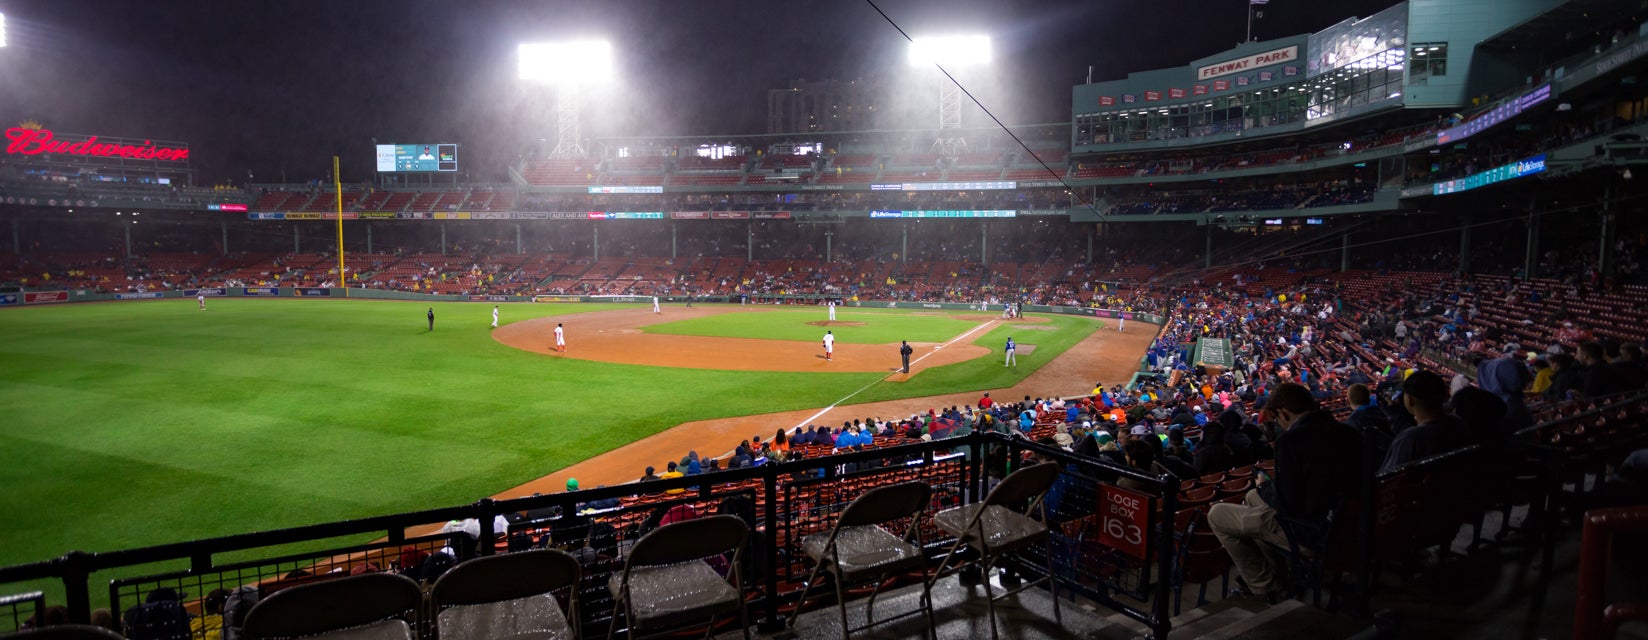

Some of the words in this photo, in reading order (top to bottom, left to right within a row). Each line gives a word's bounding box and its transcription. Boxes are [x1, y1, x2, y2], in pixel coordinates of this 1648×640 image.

[1203, 60, 1248, 77] FENWAY
[1256, 50, 1290, 64] PARK
[5, 127, 189, 161] Budweiser
[1107, 491, 1140, 510] LOGE
[1110, 504, 1135, 520] BOX
[1103, 515, 1142, 545] 163
